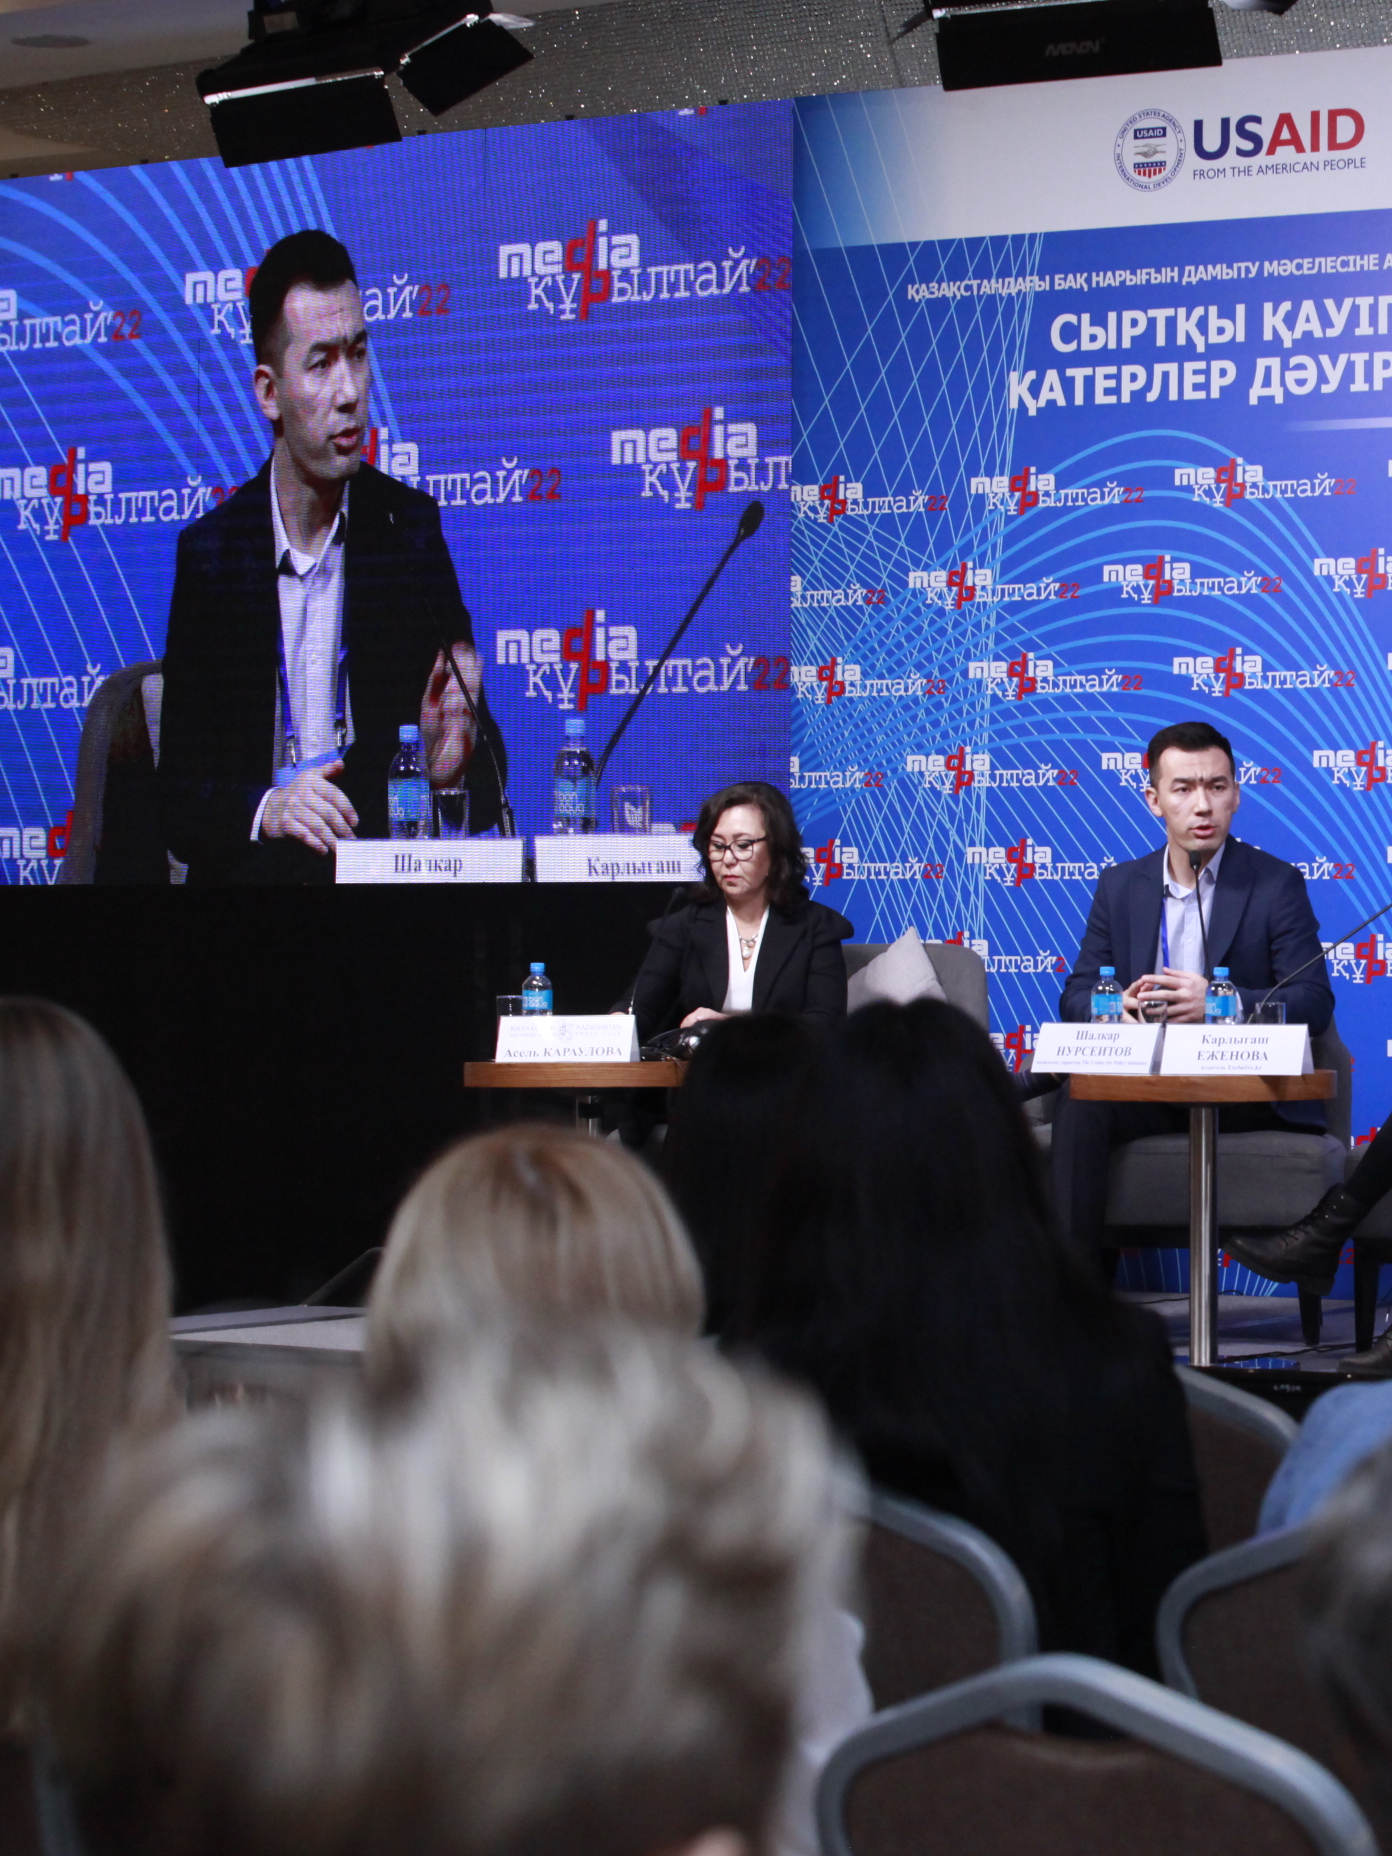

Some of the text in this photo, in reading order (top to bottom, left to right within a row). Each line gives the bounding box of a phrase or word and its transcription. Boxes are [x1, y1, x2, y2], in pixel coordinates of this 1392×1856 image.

[1119, 110, 1182, 140] UNITED STATES AGENCY
[1136, 128, 1164, 138] USAID
[1193, 108, 1365, 161] USAID
[1116, 148, 1184, 190] INTERNATIONAL DEVELOPMENT
[1193, 157, 1367, 180] FROM THE AMERICAN PEOPLE
[499, 218, 641, 279] media
[907, 275, 1050, 302] ҚАЗАҚСТАНДАҒЫ
[1054, 272, 1088, 292] БАҚ
[1092, 266, 1179, 289] НАРЫҒЫН
[1182, 261, 1260, 284] ДАМЫТУ
[1263, 255, 1379, 278] МӘСЕЛЕСІНЕ
[1050, 303, 1246, 353] СЫРТҚЫ
[1009, 359, 1237, 416] ҚАТЕРЛЕР
[610, 405, 758, 466] media
[970, 466, 1055, 494] media
[1174, 457, 1263, 485] media
[907, 561, 992, 588] media
[1102, 554, 1190, 581] media
[496, 609, 638, 664] media
[968, 651, 1054, 678] media
[1172, 647, 1262, 674] media
[905, 745, 990, 771] media
[966, 838, 1052, 864] media
[1075, 1029, 1120, 1043] Шалкар
[1201, 1033, 1269, 1047] Карлыгаш
[503, 1045, 623, 1058] Асель КАРАУЛОВА
[1196, 1050, 1269, 1061] ЕЖЕНОВА
